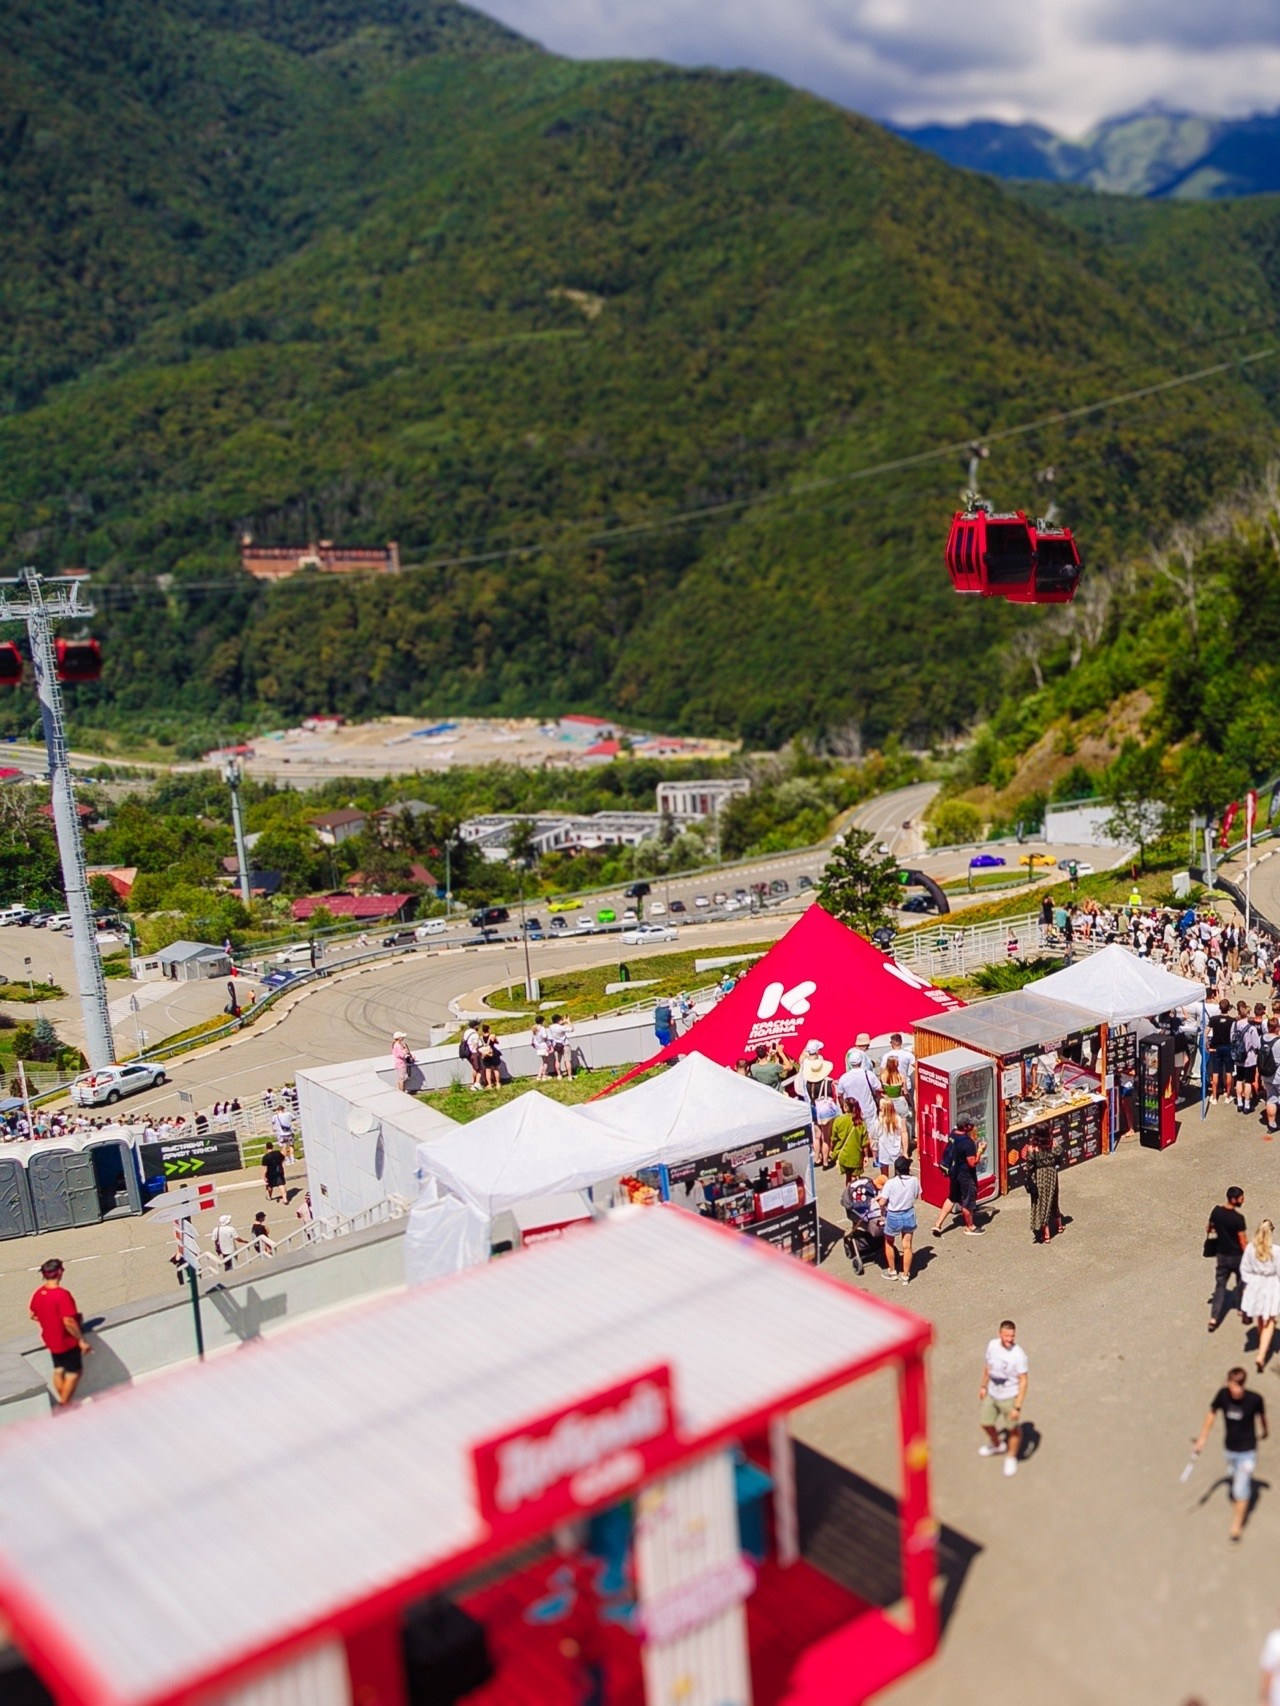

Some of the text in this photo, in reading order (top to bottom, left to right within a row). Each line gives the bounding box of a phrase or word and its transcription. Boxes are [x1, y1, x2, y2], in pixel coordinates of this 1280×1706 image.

[752, 1017, 805, 1031] КРАСНАЯ
[749, 1025, 796, 1039] ПОЛЯНА
[161, 1140, 204, 1153] ВЫСТАВКА
[162, 1145, 218, 1160] ДРИФТ ТАКСИ
